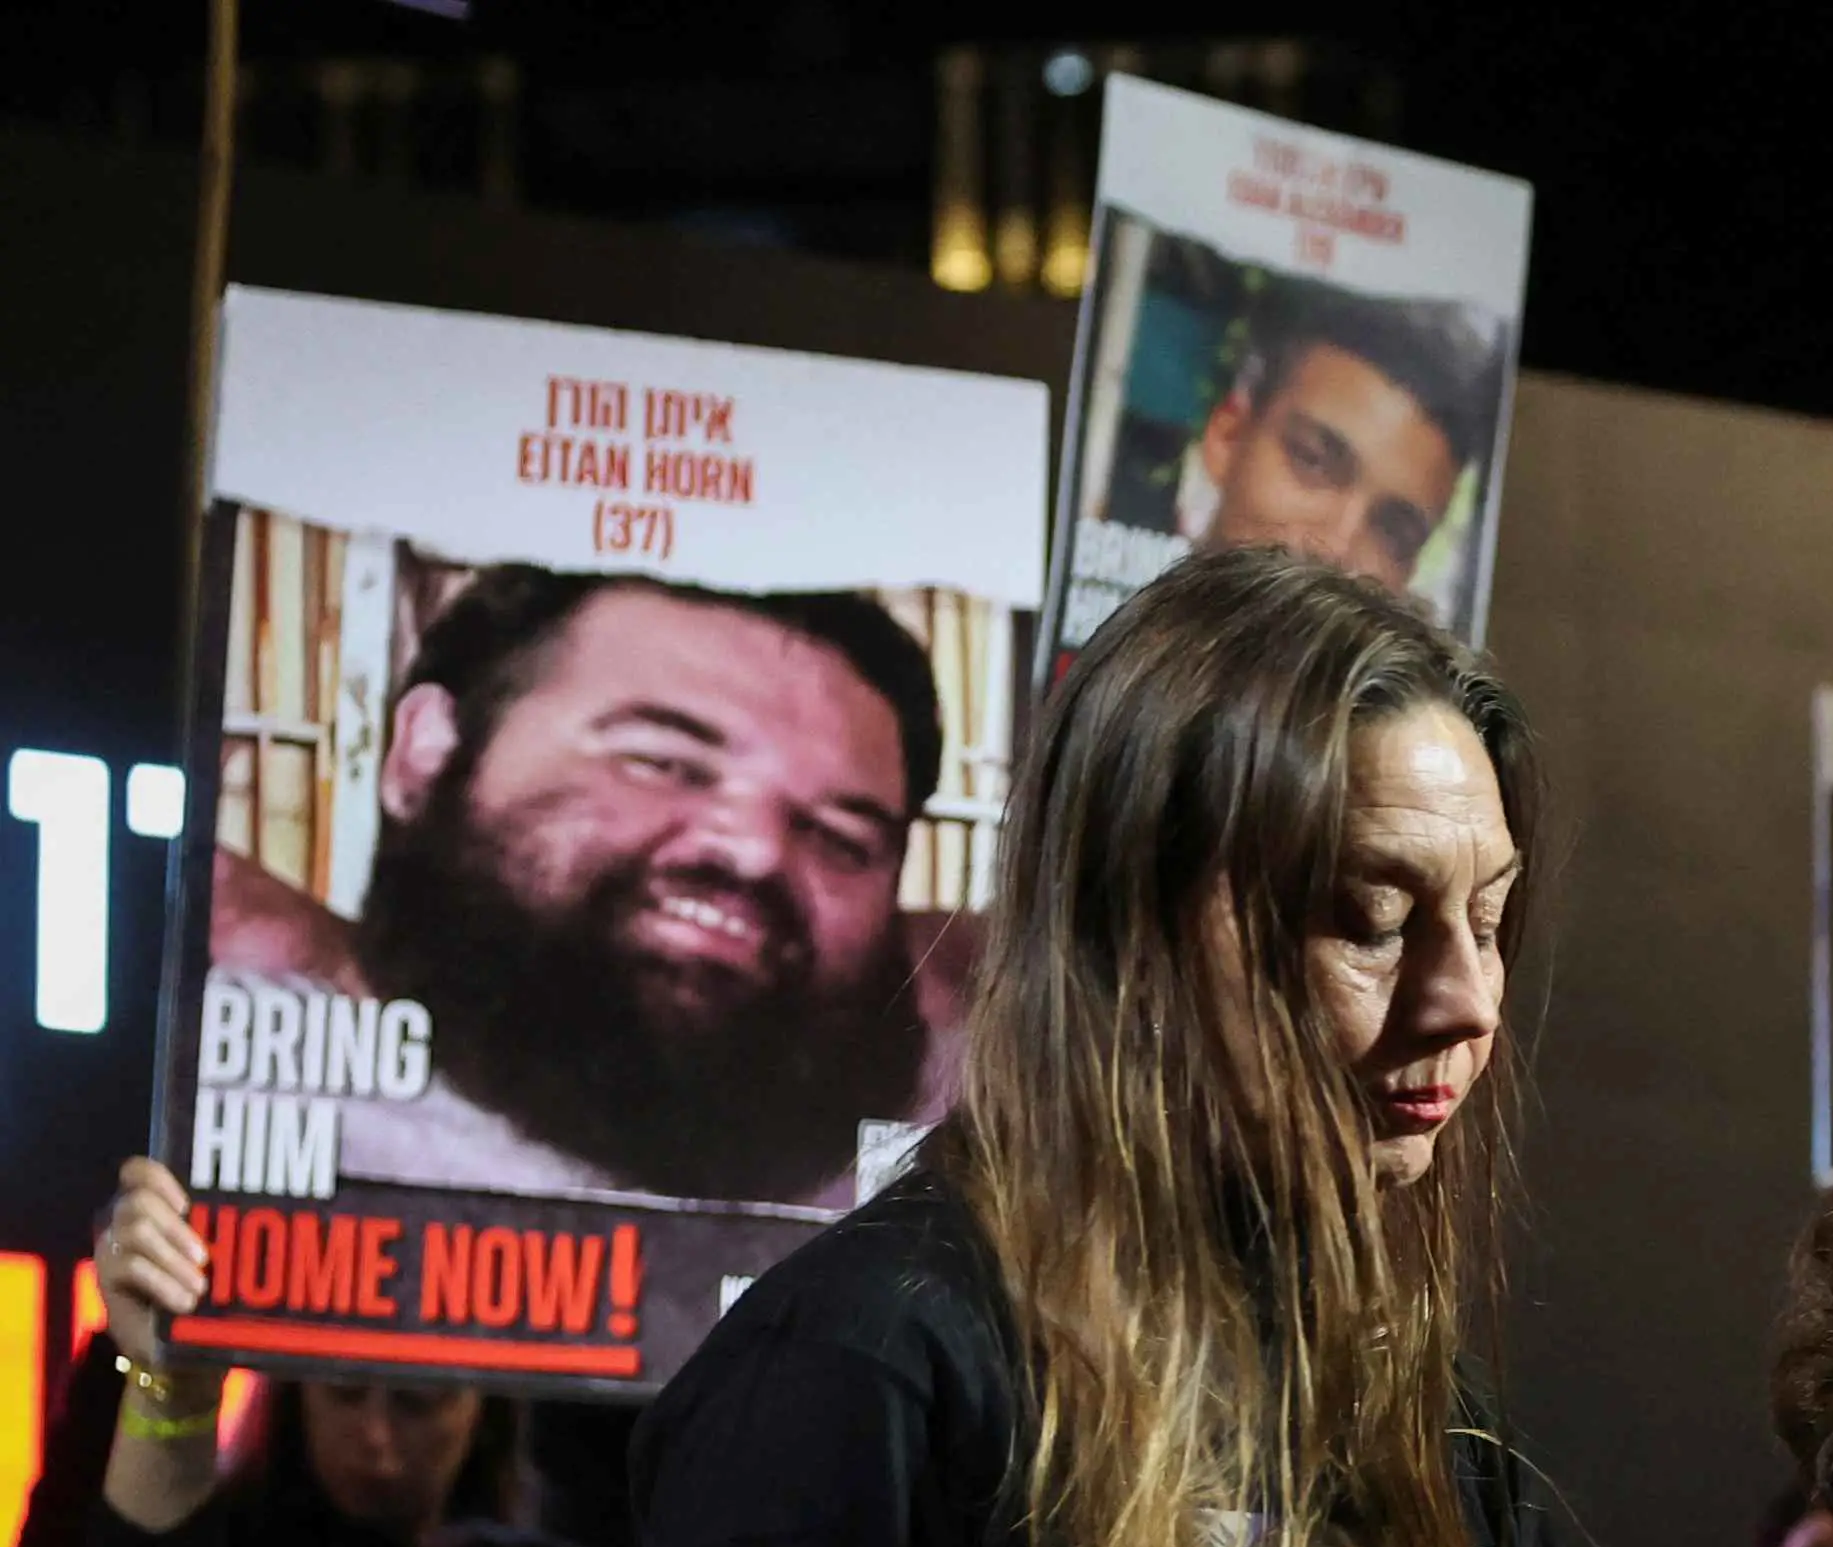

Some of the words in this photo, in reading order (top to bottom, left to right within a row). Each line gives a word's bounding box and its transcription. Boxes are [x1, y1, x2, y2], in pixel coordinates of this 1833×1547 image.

[546, 374, 628, 431] הורן
[645, 386, 735, 444] איתן
[517, 432, 631, 493] EITAN
[645, 447, 755, 504] HORN
[593, 498, 675, 561] (37)
[201, 976, 433, 1100] BRING
[191, 1091, 341, 1199] HIM
[191, 1205, 400, 1318] HOME
[420, 1224, 643, 1339] NOW!
